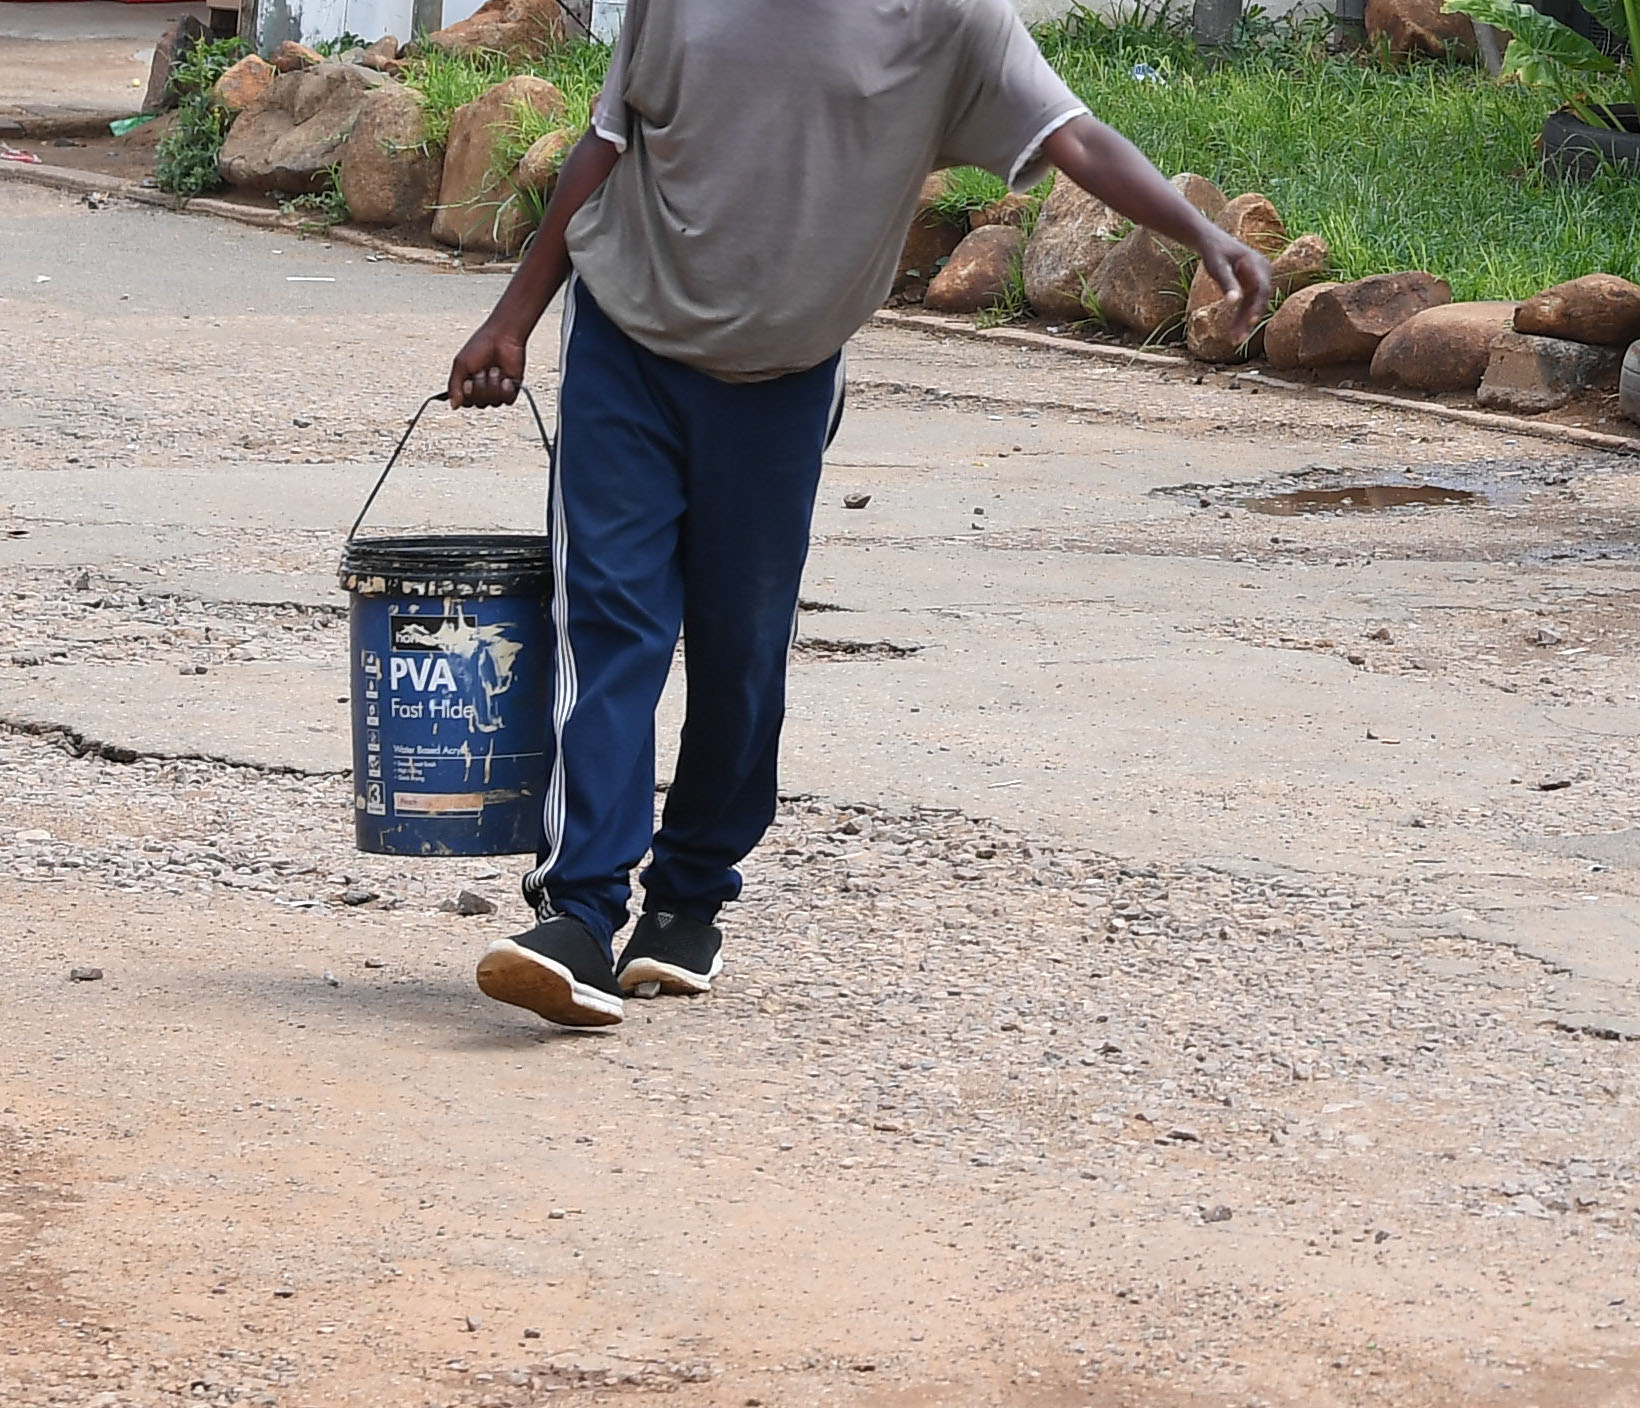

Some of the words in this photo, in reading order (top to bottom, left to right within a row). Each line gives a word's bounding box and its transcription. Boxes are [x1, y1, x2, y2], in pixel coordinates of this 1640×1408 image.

[390, 657, 457, 692] PVA
[391, 697, 423, 718] Fast
[429, 698, 474, 719] Hide
[393, 744, 415, 754] Water
[417, 744, 440, 755] Based
